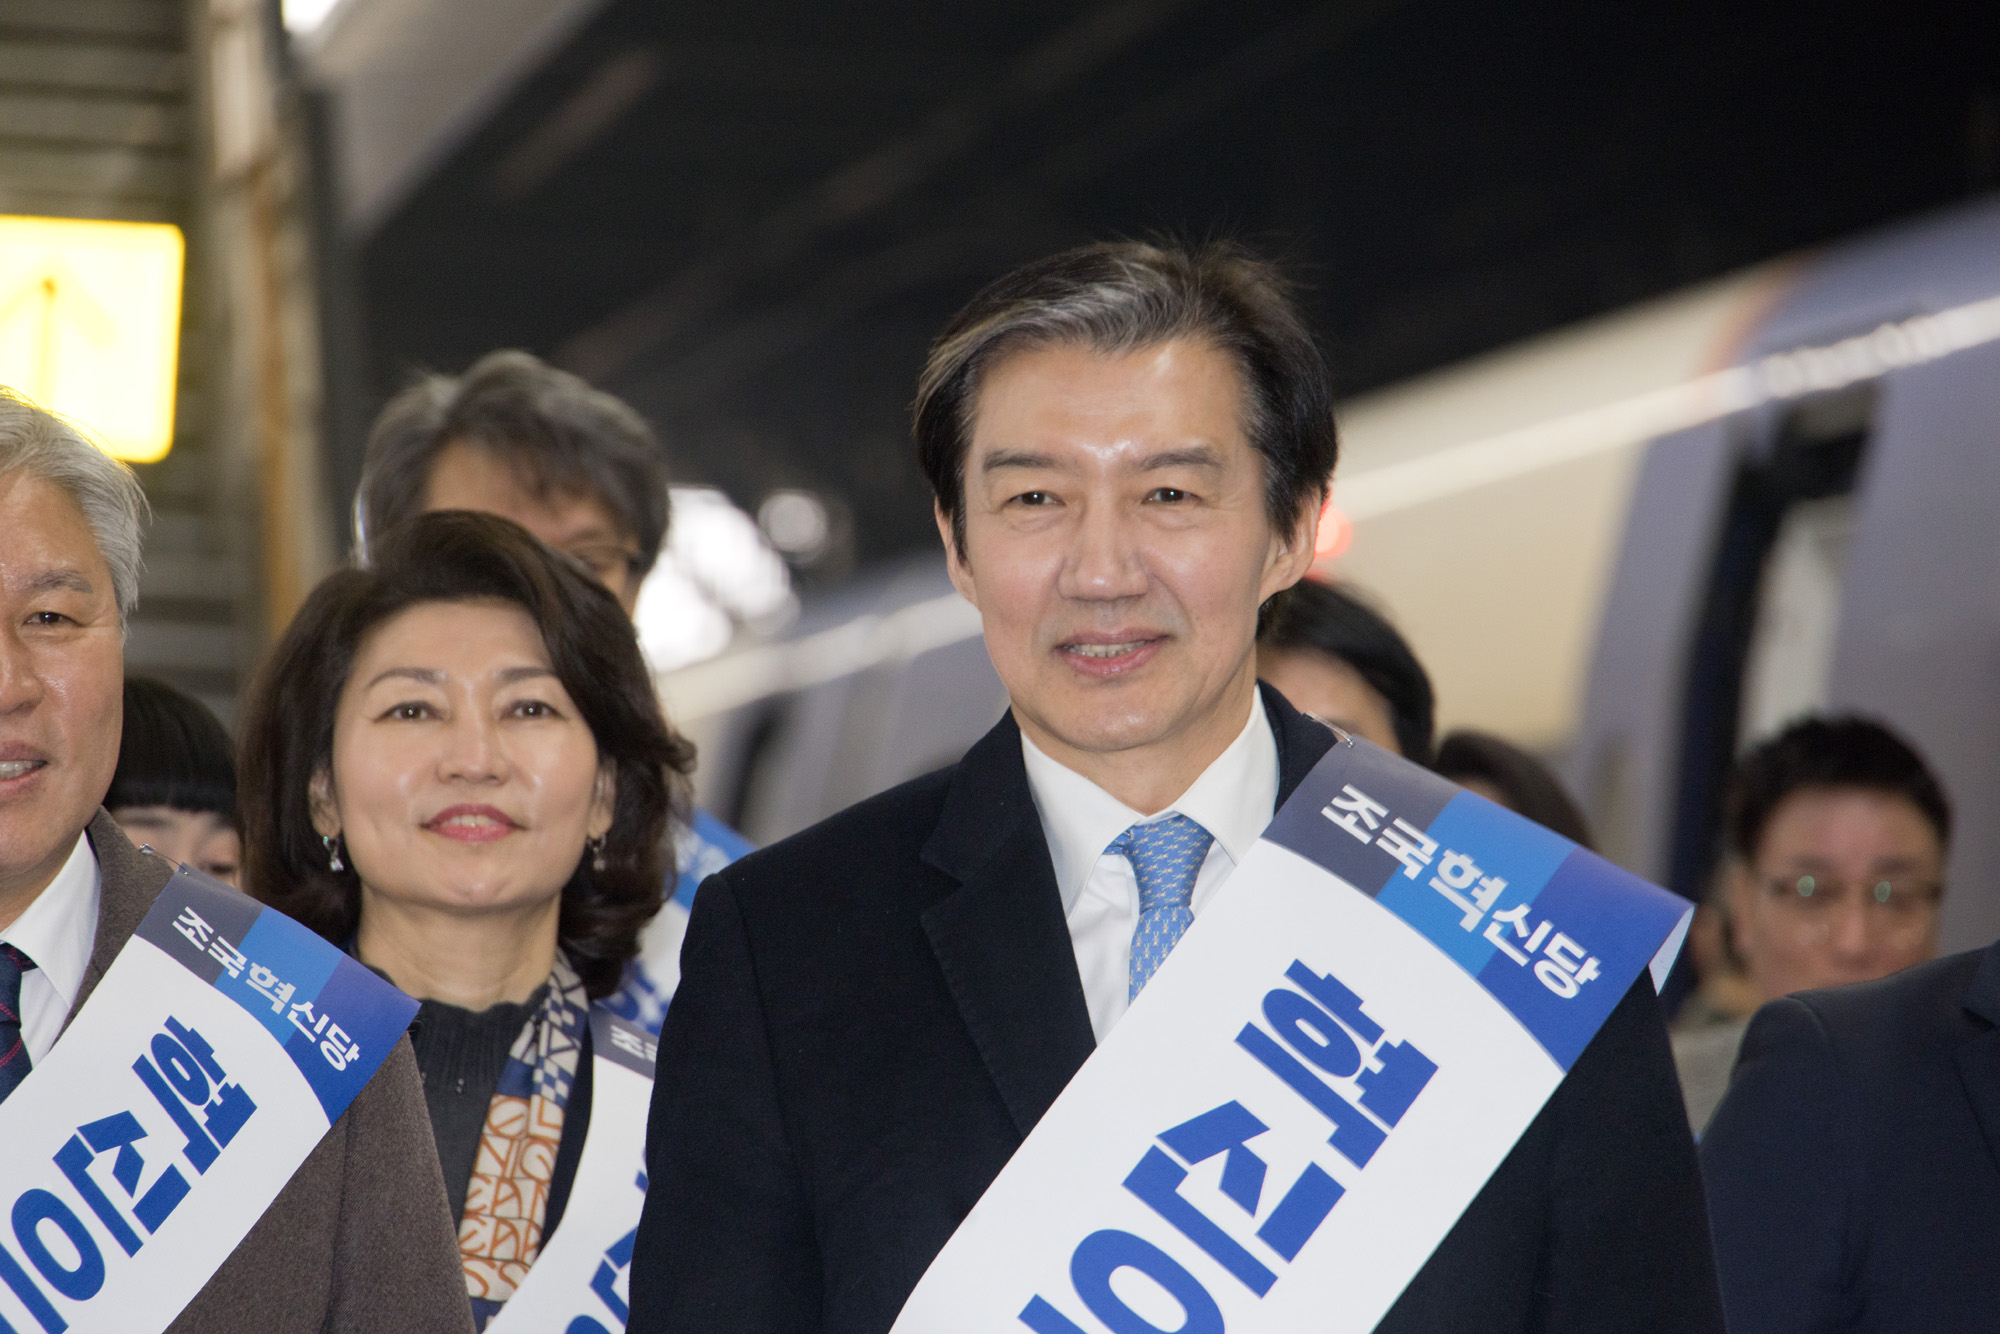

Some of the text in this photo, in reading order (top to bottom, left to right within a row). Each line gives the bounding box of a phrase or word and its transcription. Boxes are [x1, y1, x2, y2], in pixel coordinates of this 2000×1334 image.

[173, 906, 360, 1071] 조국혁신당
[1321, 784, 1600, 999] 조국혁신당
[0, 1014, 258, 1334] 혁신으
